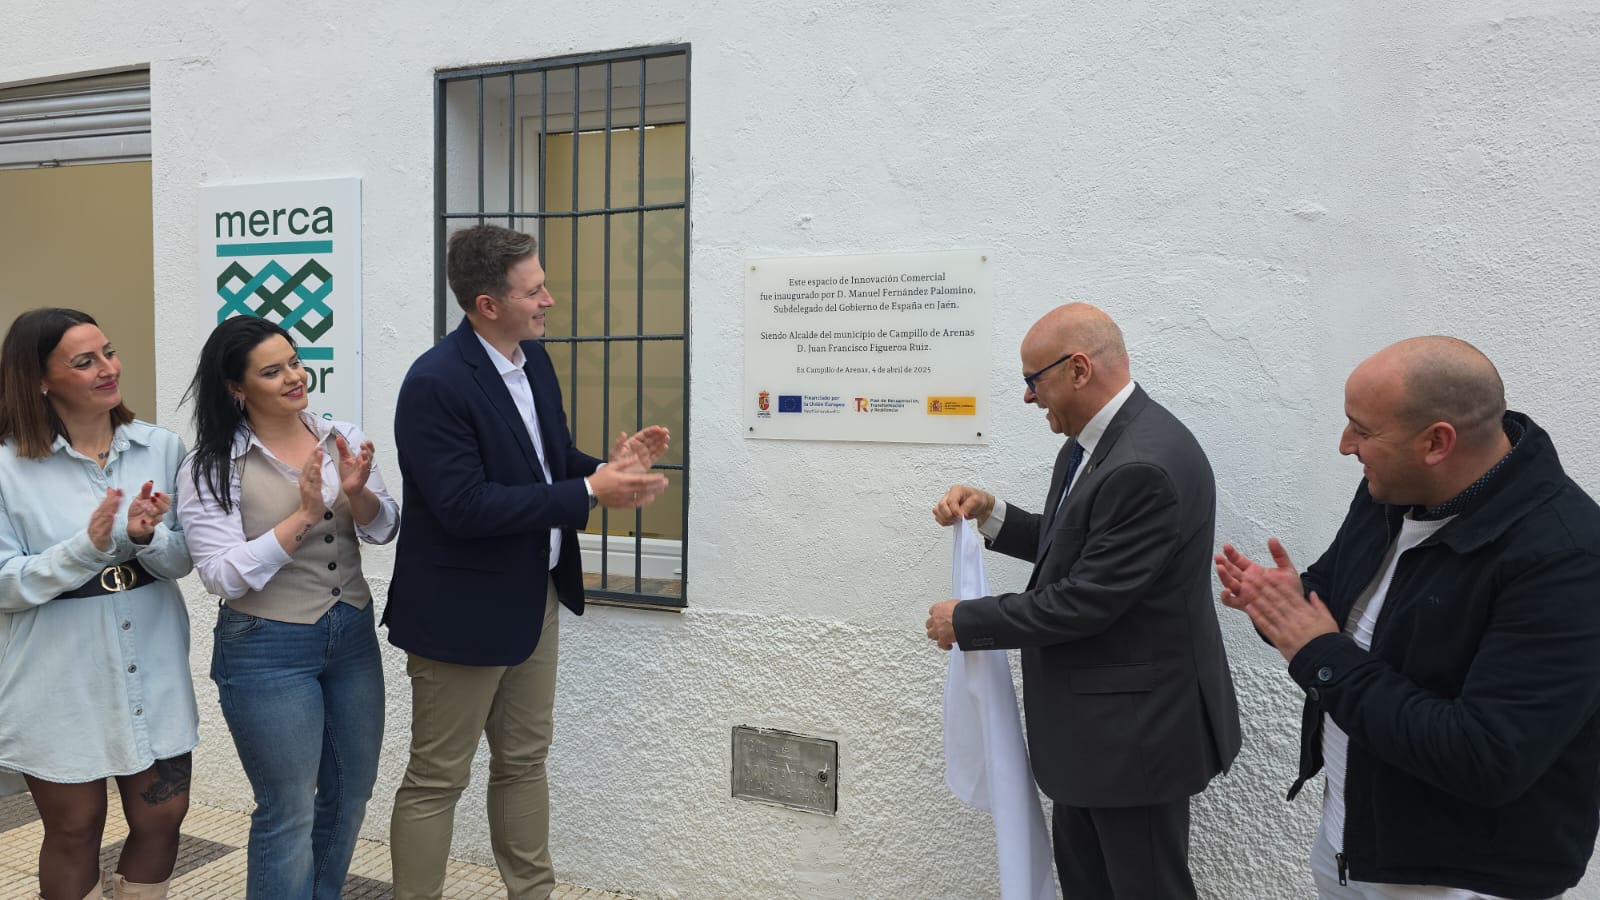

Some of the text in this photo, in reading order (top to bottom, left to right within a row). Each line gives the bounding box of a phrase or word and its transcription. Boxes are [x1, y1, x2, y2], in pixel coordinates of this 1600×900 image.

[215, 206, 334, 239] merca
[789, 272, 946, 288] Este espacio de Innovación Comercial
[760, 285, 976, 302] fue inaugurado por D. Manuel Fernández Palomino,
[773, 304, 824, 315] Subdelegado
[825, 303, 837, 312] del
[839, 302, 878, 312] Gobierno
[879, 302, 890, 311] de
[891, 301, 923, 313] España
[937, 300, 960, 310] Jaén.
[760, 328, 975, 341] Siendo Alcalde del municipio de Campillo de Arenas
[797, 343, 932, 354] D. Juan Francisco Figueroa Ruiz.
[796, 366, 805, 374] En
[806, 366, 835, 375] Campillo
[836, 366, 843, 374] de
[845, 366, 871, 375] Arenas,
[886, 365, 903, 373] abril
[904, 365, 912, 373] de
